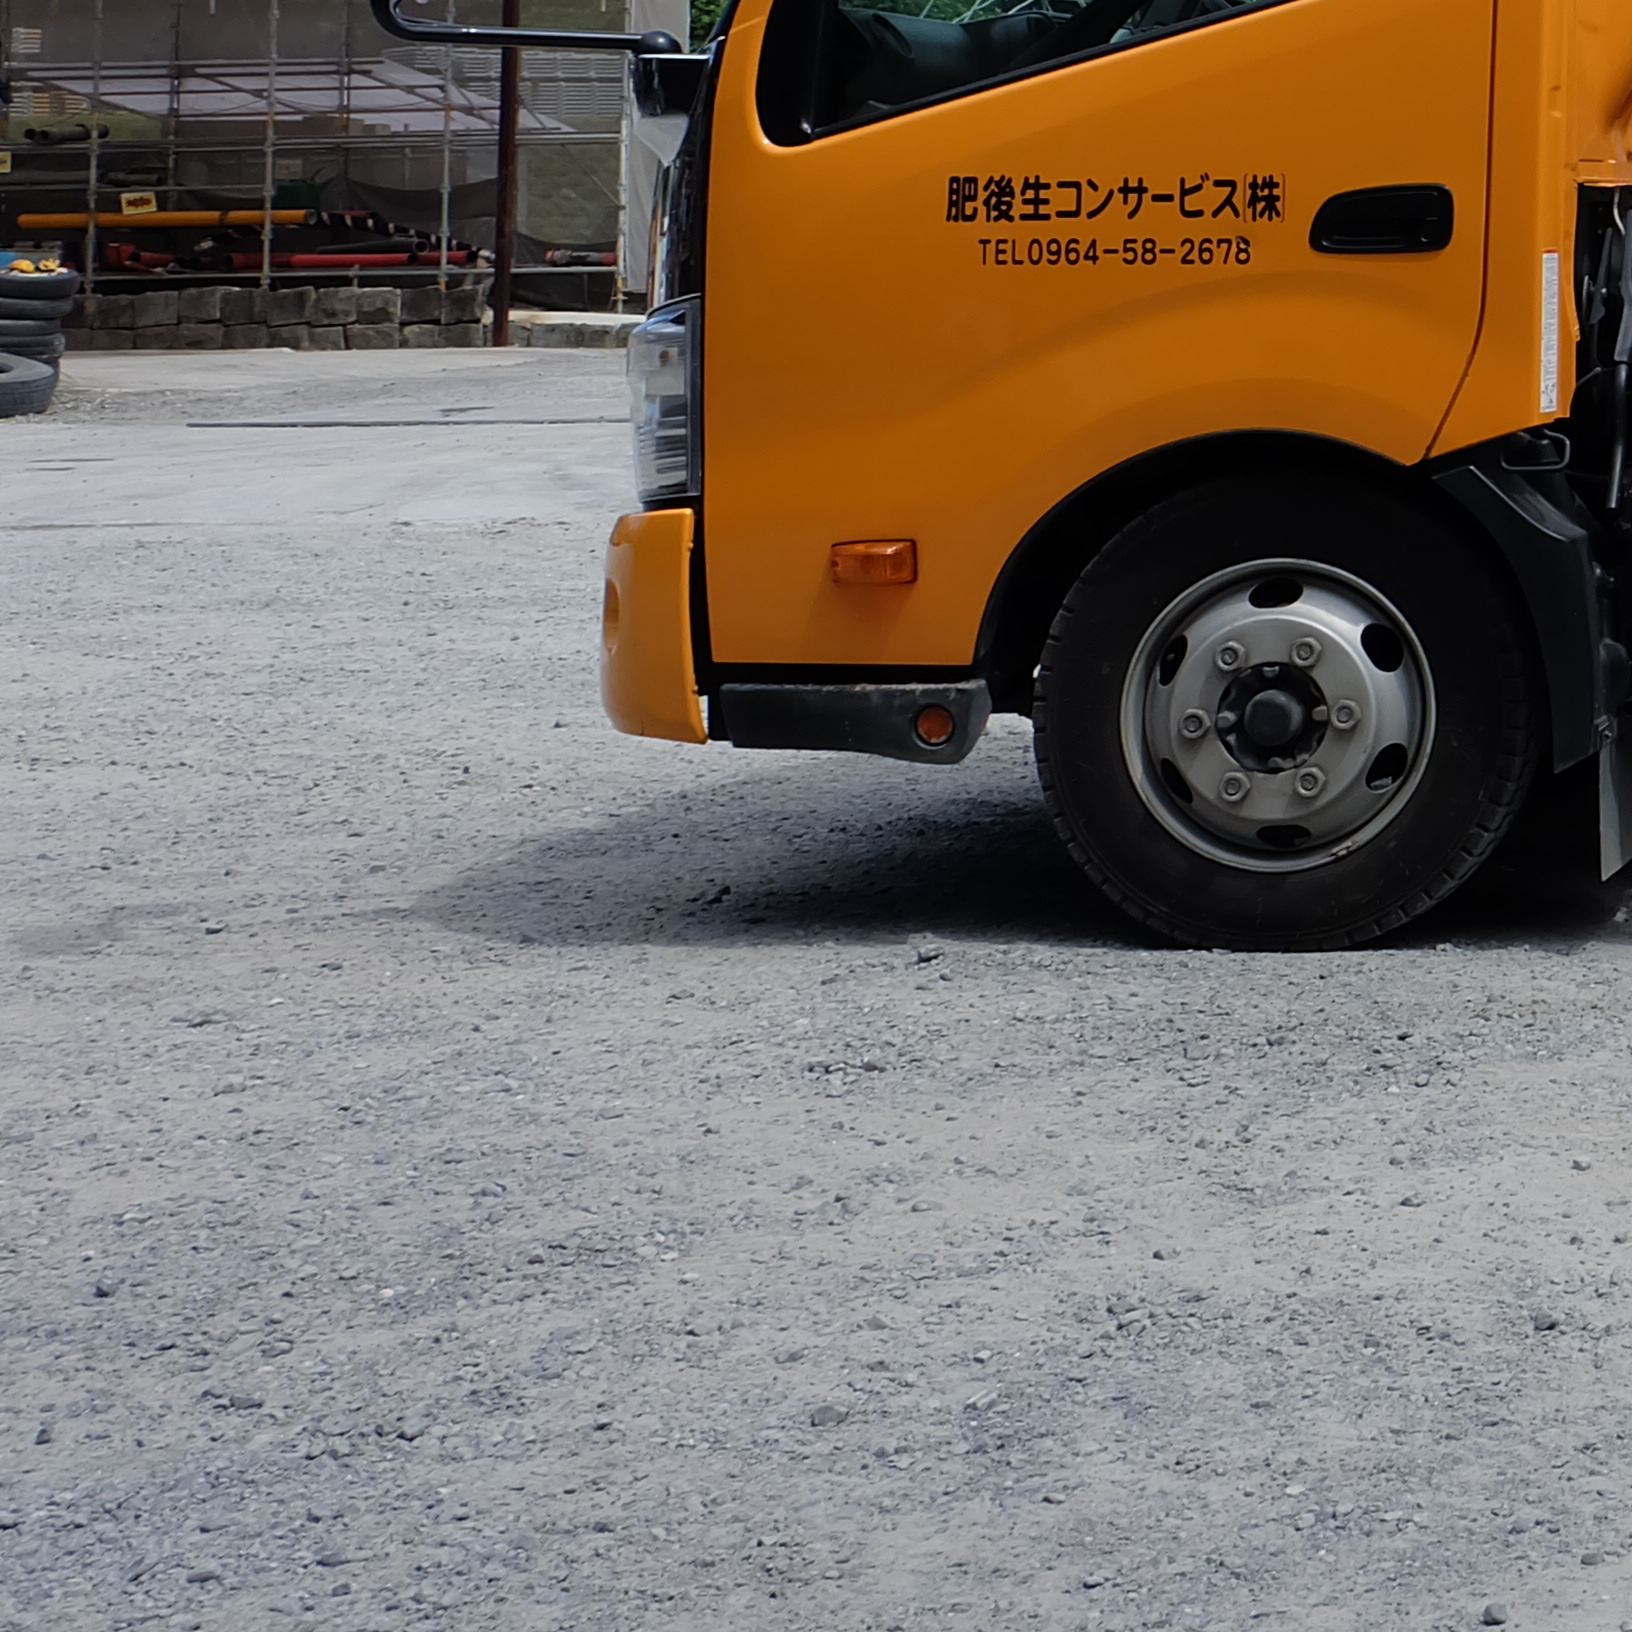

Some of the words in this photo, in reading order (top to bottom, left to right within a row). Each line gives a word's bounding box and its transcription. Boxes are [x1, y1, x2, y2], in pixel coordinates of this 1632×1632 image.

[945, 172, 1286, 223] 肥後生コンサービス(株)
[978, 237, 1251, 265] TEL0964-58-2678
